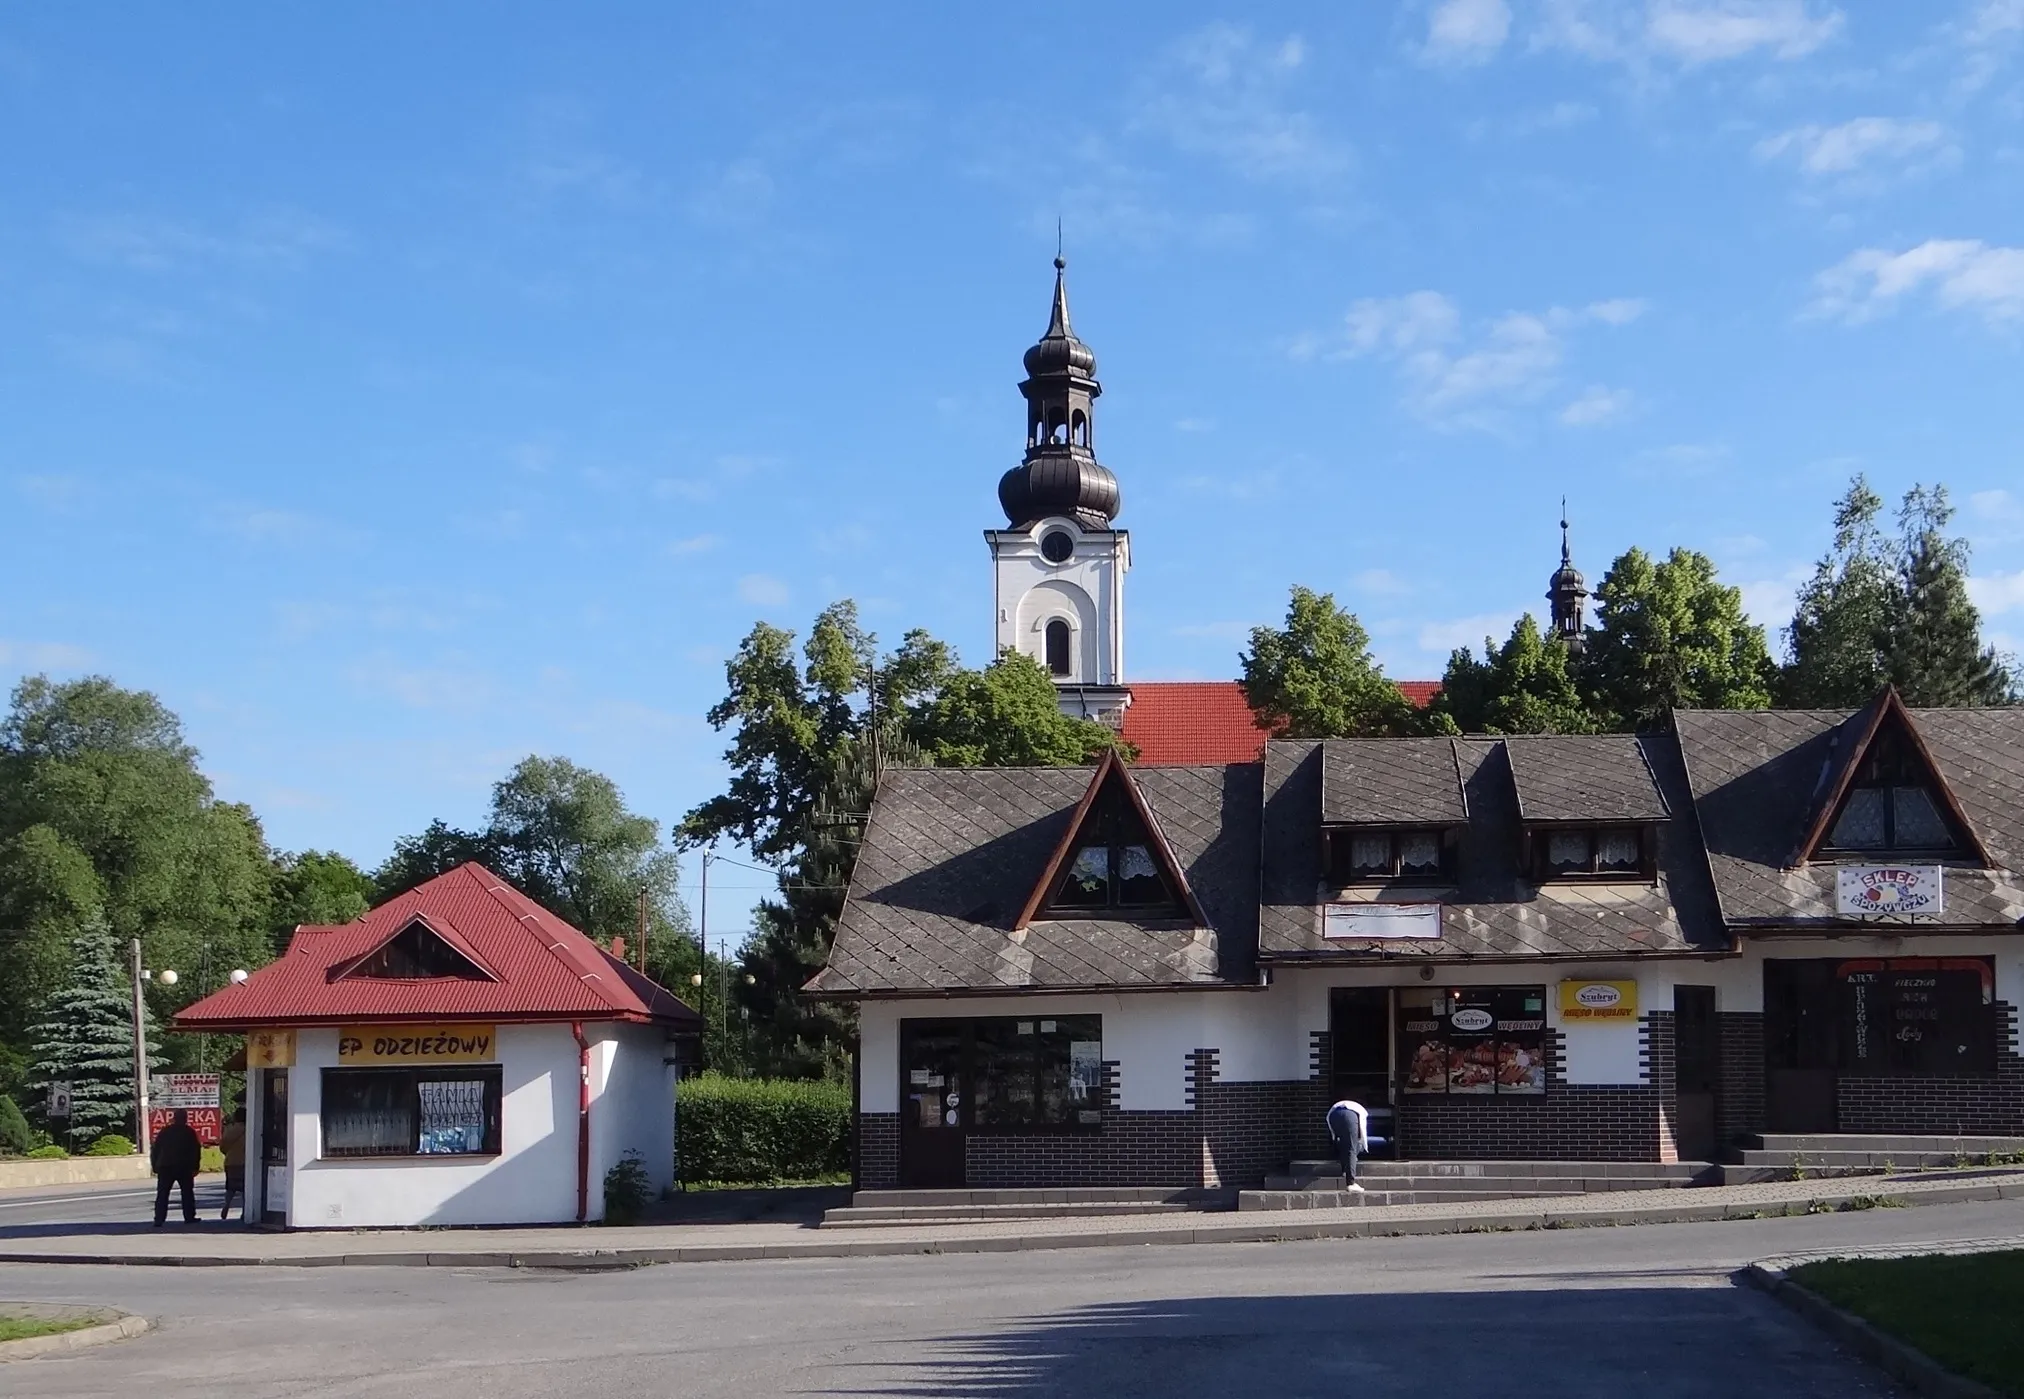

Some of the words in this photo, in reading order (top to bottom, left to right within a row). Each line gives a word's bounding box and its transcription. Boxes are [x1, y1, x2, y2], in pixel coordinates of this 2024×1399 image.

[1862, 870, 1917, 887] SKLEP
[1580, 992, 1617, 1001] Szubryt
[1455, 1017, 1489, 1025] Szubryt
[373, 1031, 489, 1056] ODZIEŻOWY
[421, 1087, 478, 1104] TANIA
[153, 1110, 216, 1123] APEKA
